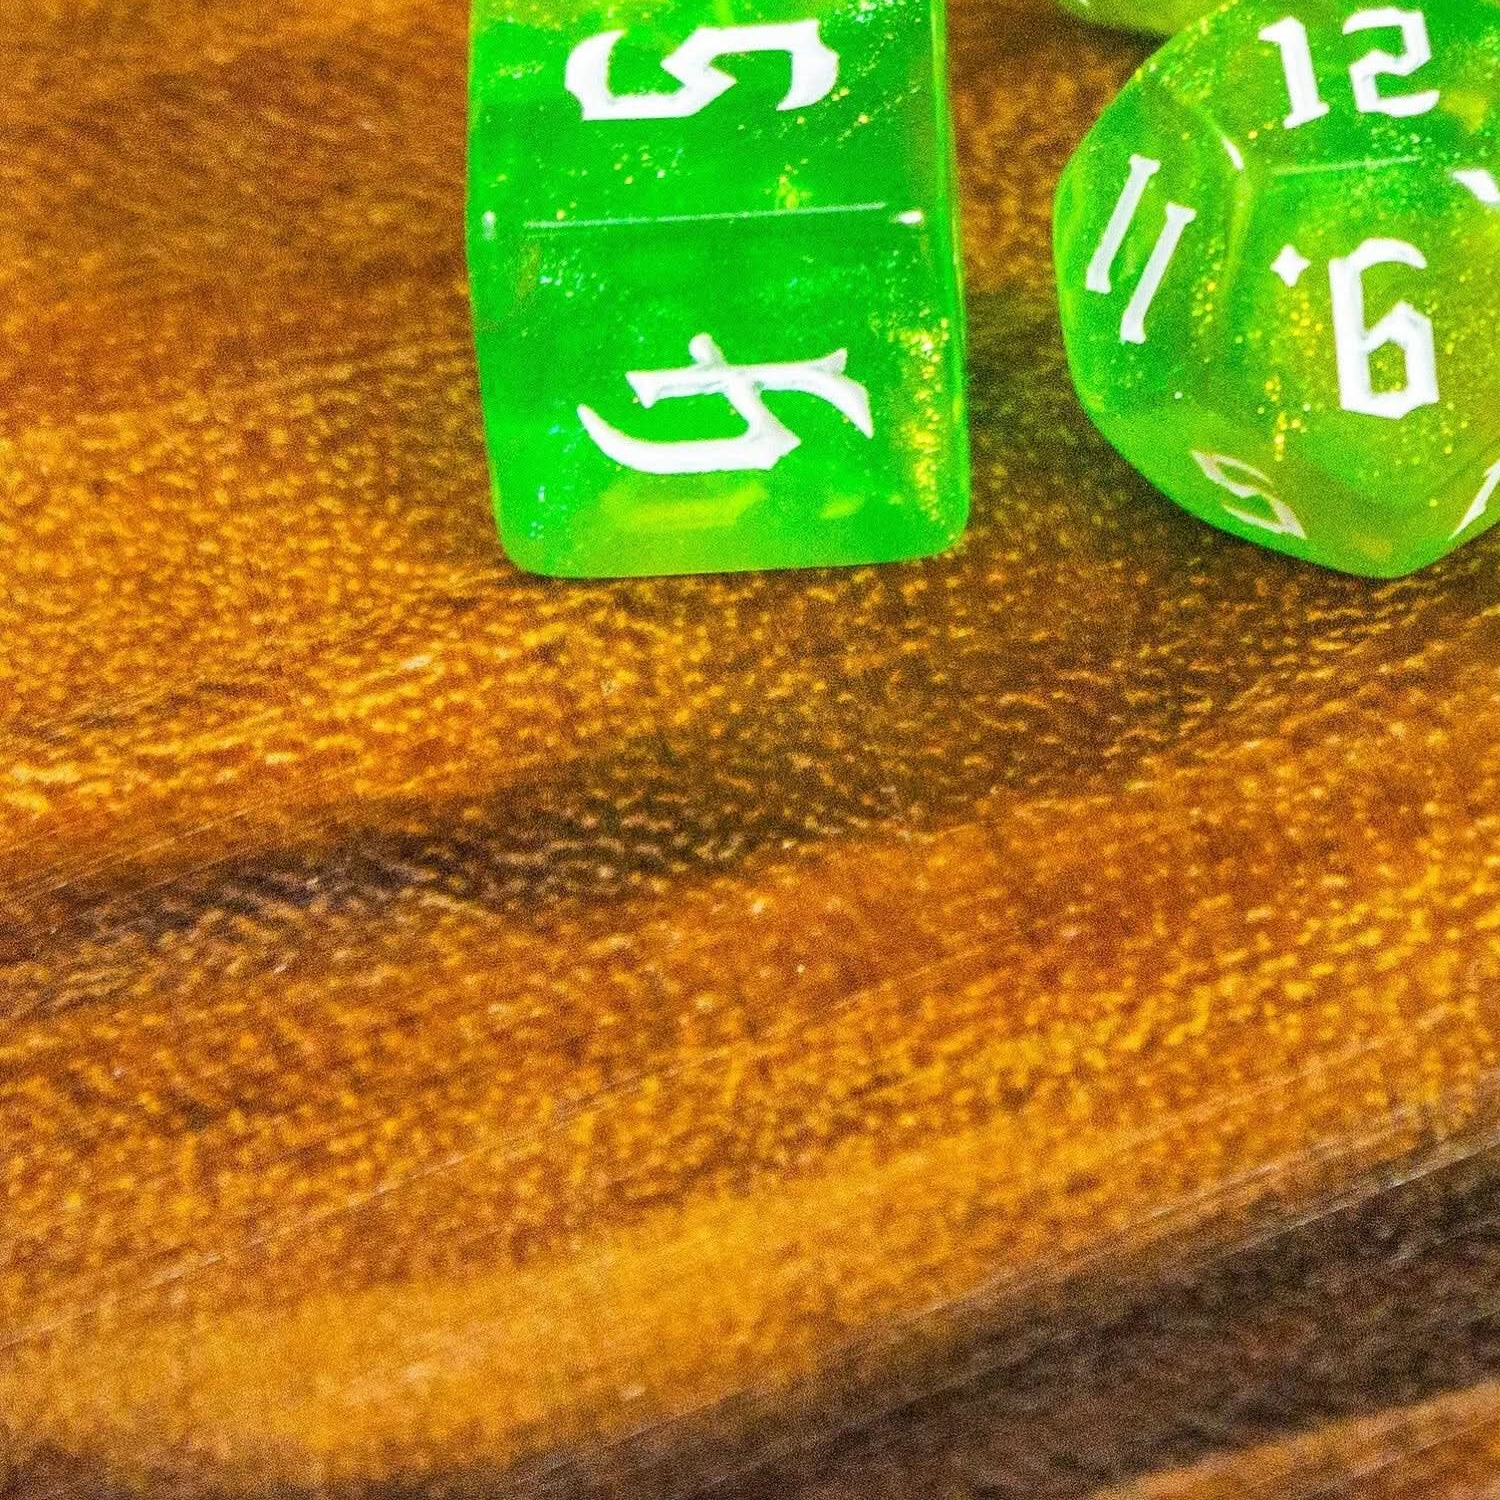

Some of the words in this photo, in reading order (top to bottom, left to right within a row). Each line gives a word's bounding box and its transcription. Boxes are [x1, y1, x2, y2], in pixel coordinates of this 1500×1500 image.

[563, 18, 840, 122] 5
[1257, 5, 1441, 130] 12
[1084, 153, 1197, 345] 11
[576, 333, 874, 476] 4
